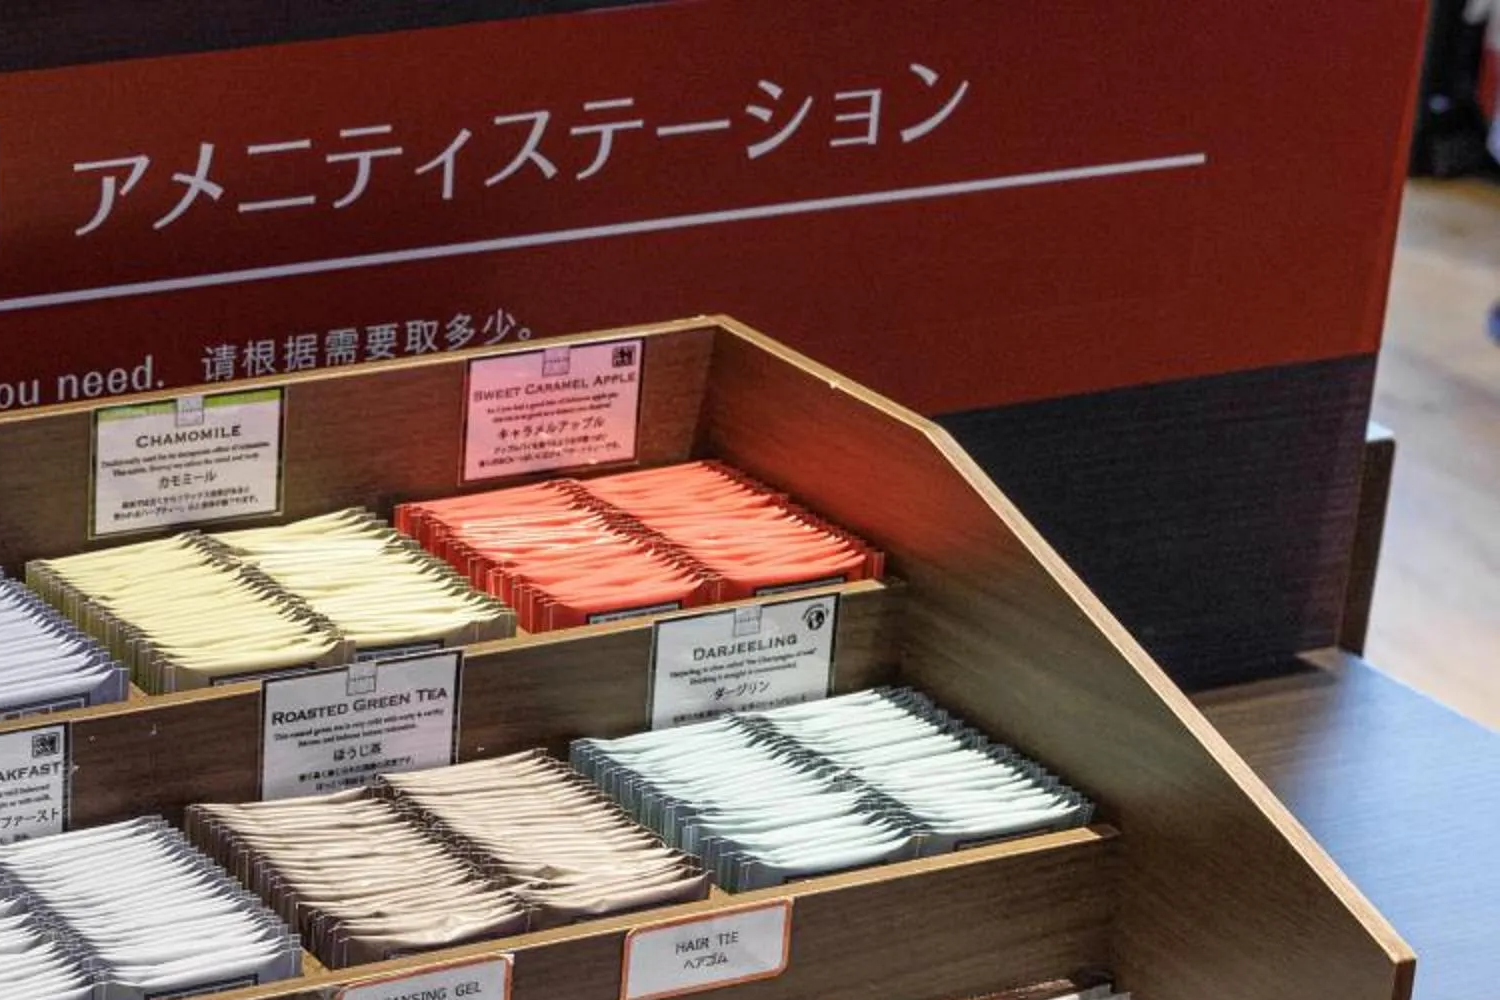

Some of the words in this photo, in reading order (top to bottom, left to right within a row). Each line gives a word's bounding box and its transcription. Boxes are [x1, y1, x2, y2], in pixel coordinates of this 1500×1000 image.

[73, 62, 969, 237] アメニティステーション
[202, 310, 532, 381] 请根据需要取多少。
[57, 356, 165, 399] need.
[474, 387, 521, 402] SWEET
[525, 379, 588, 395] CARAMEL
[593, 372, 636, 386] APPLE
[135, 425, 241, 448] CHAMOMILE
[159, 470, 218, 490] カモミール
[693, 634, 798, 661] DARJEELING
[272, 703, 349, 726] ROASTED
[353, 692, 411, 713] GREEN
[416, 687, 447, 703] TEA
[675, 937, 709, 955] HAIR
[718, 931, 739, 947] TIE
[455, 981, 482, 997] GEL
